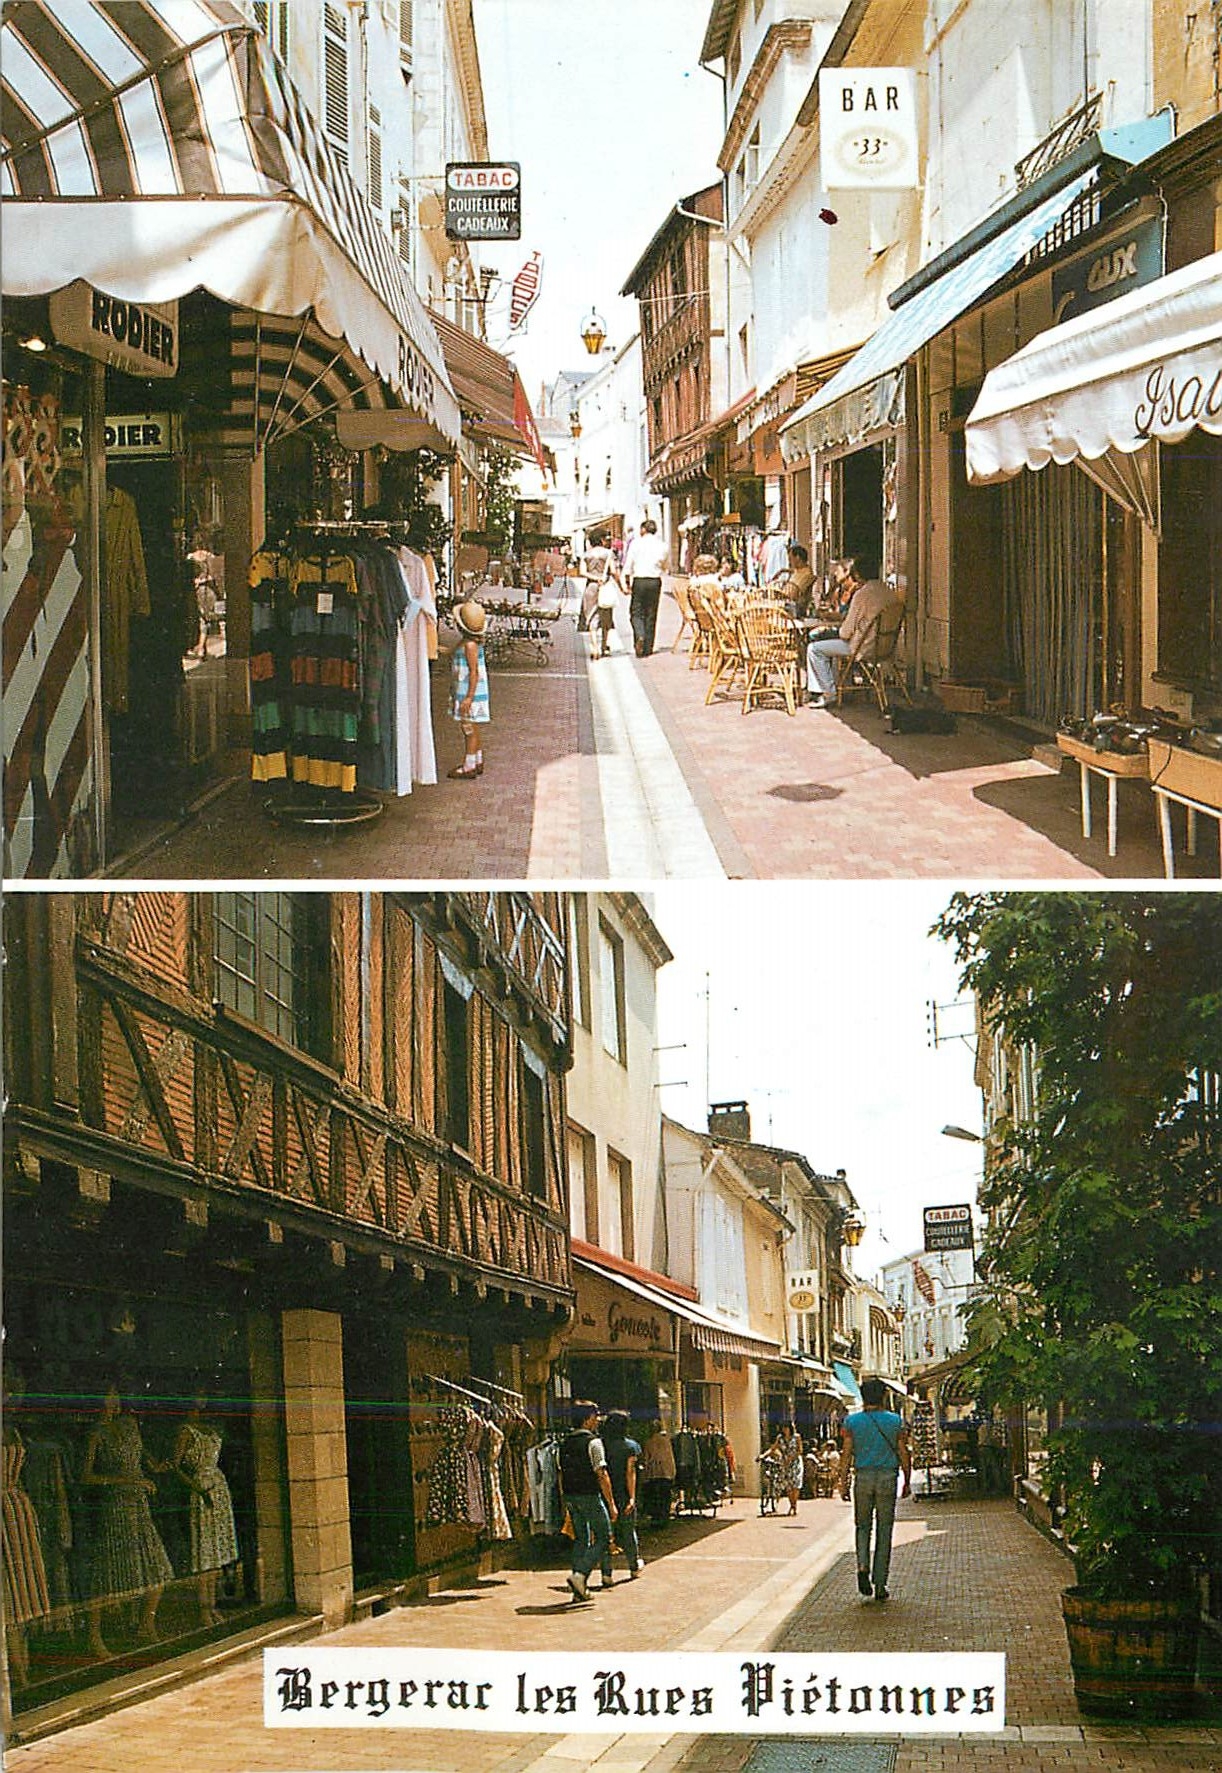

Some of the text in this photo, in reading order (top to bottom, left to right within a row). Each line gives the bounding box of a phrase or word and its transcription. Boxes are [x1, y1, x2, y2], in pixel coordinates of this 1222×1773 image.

[842, 86, 899, 112] BAR
[454, 172, 512, 187] TABAC
[449, 197, 518, 213] COUTELLERIE
[457, 217, 509, 232] CADEAUX
[92, 290, 174, 367] RODIER
[61, 424, 162, 448] RDIER
[927, 1209, 967, 1221] TABAC
